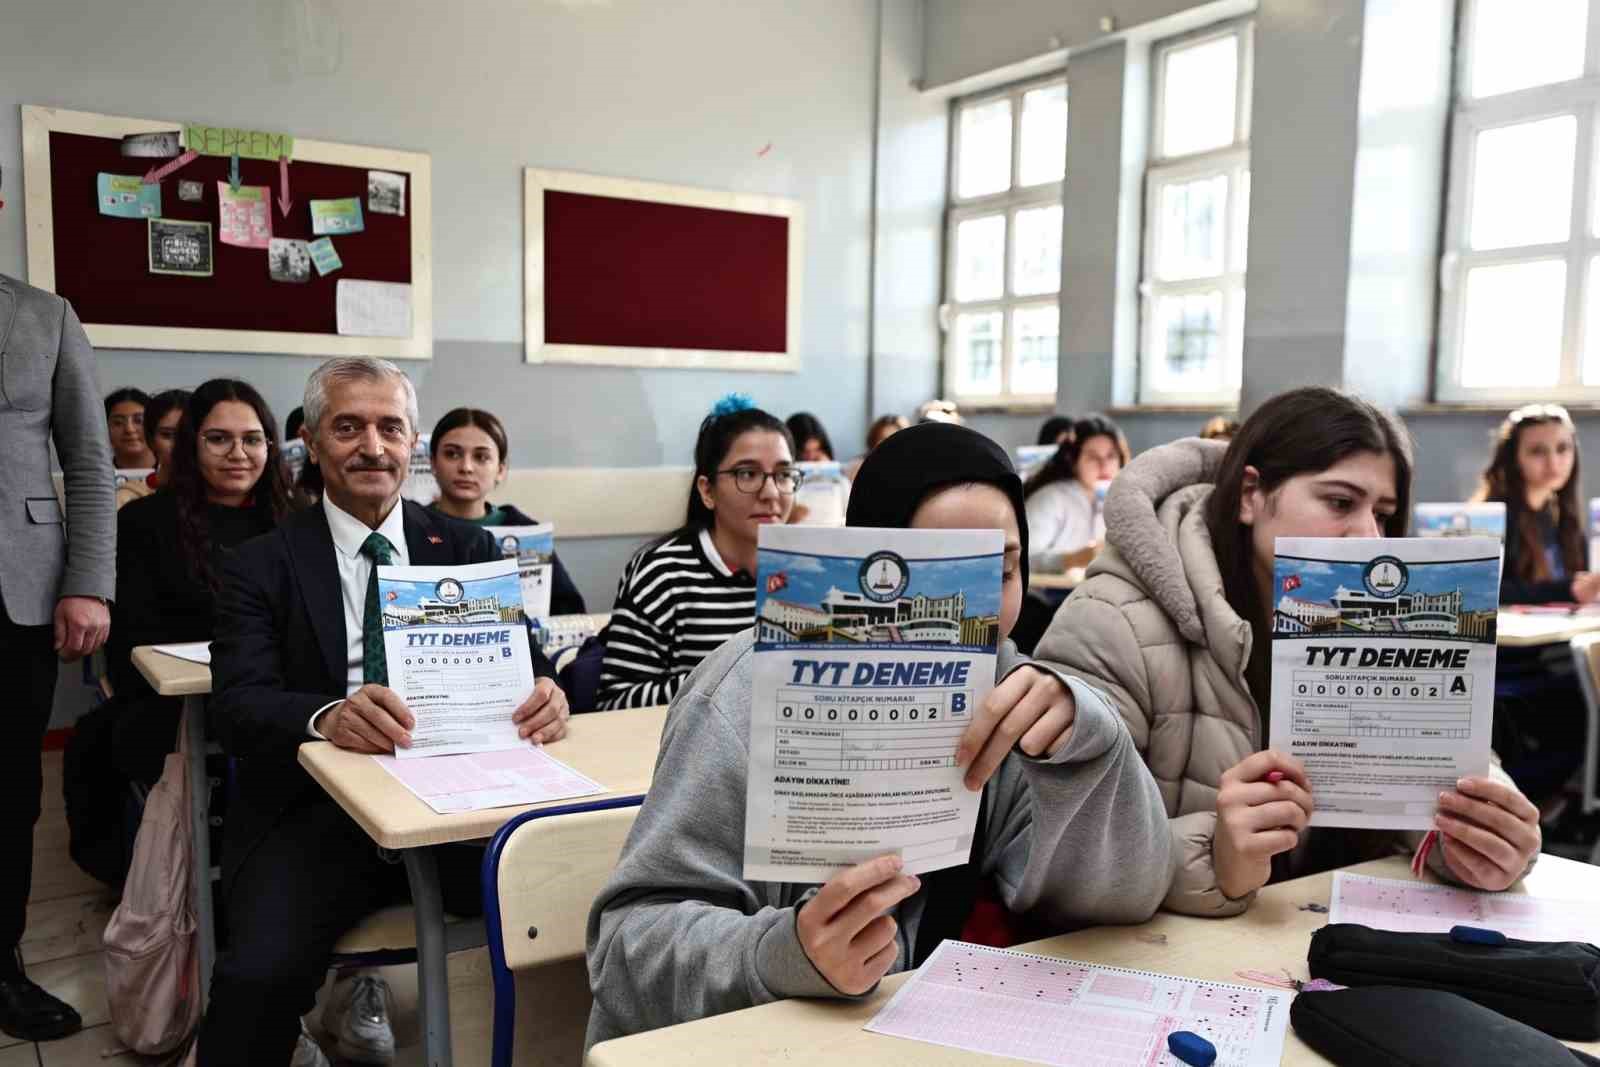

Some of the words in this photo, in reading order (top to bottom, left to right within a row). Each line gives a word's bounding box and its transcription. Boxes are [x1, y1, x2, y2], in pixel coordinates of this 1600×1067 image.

[406, 632, 439, 646] TYT
[442, 630, 510, 646] DENEME
[502, 647, 512, 658] B
[1305, 646, 1356, 666] TYT
[1358, 648, 1470, 668] DENEME
[792, 660, 850, 685] TYT
[852, 661, 972, 686] DENEME
[1450, 676, 1467, 692] A
[952, 692, 966, 712] B
[774, 776, 804, 784] ADAYIN
